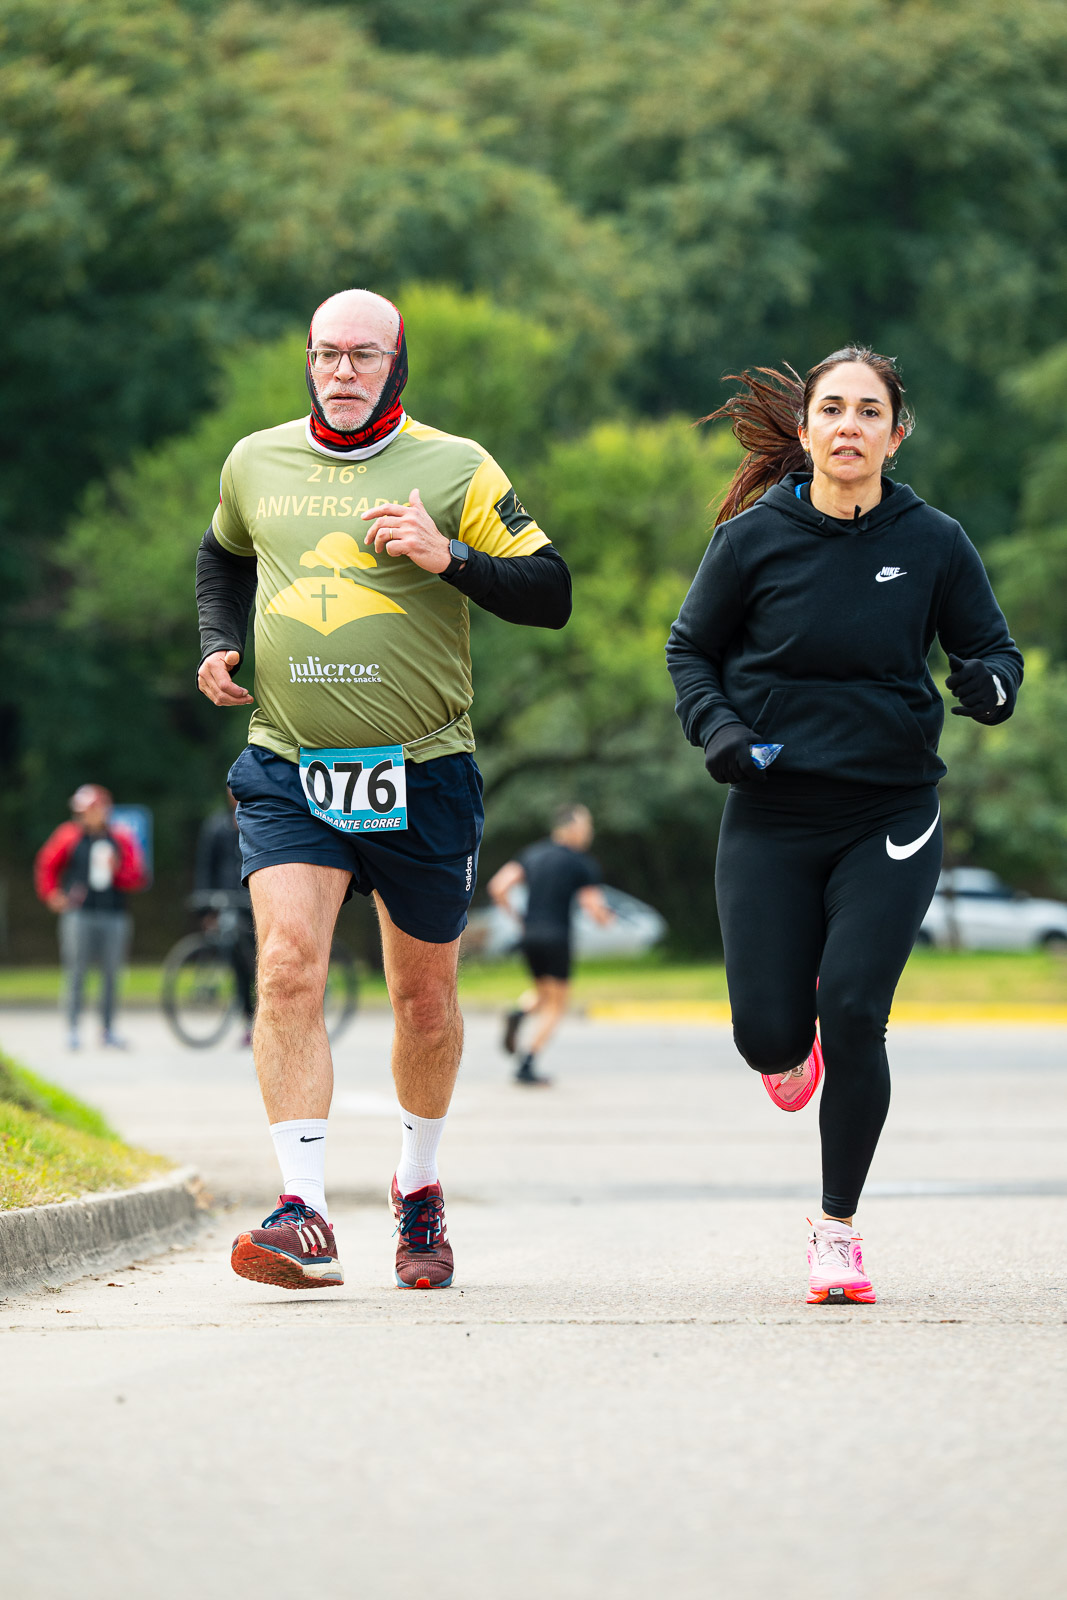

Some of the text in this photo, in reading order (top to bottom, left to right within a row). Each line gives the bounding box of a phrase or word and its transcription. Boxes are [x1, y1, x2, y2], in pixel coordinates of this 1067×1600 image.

[306, 464, 367, 484] 216°
[880, 566, 901, 576] NIKE
[288, 656, 380, 683] julicroc
[353, 675, 382, 683] snacks
[306, 759, 397, 815] 076
[314, 808, 402, 830] DIAMANTE CORRE
[465, 855, 473, 891] adidas
